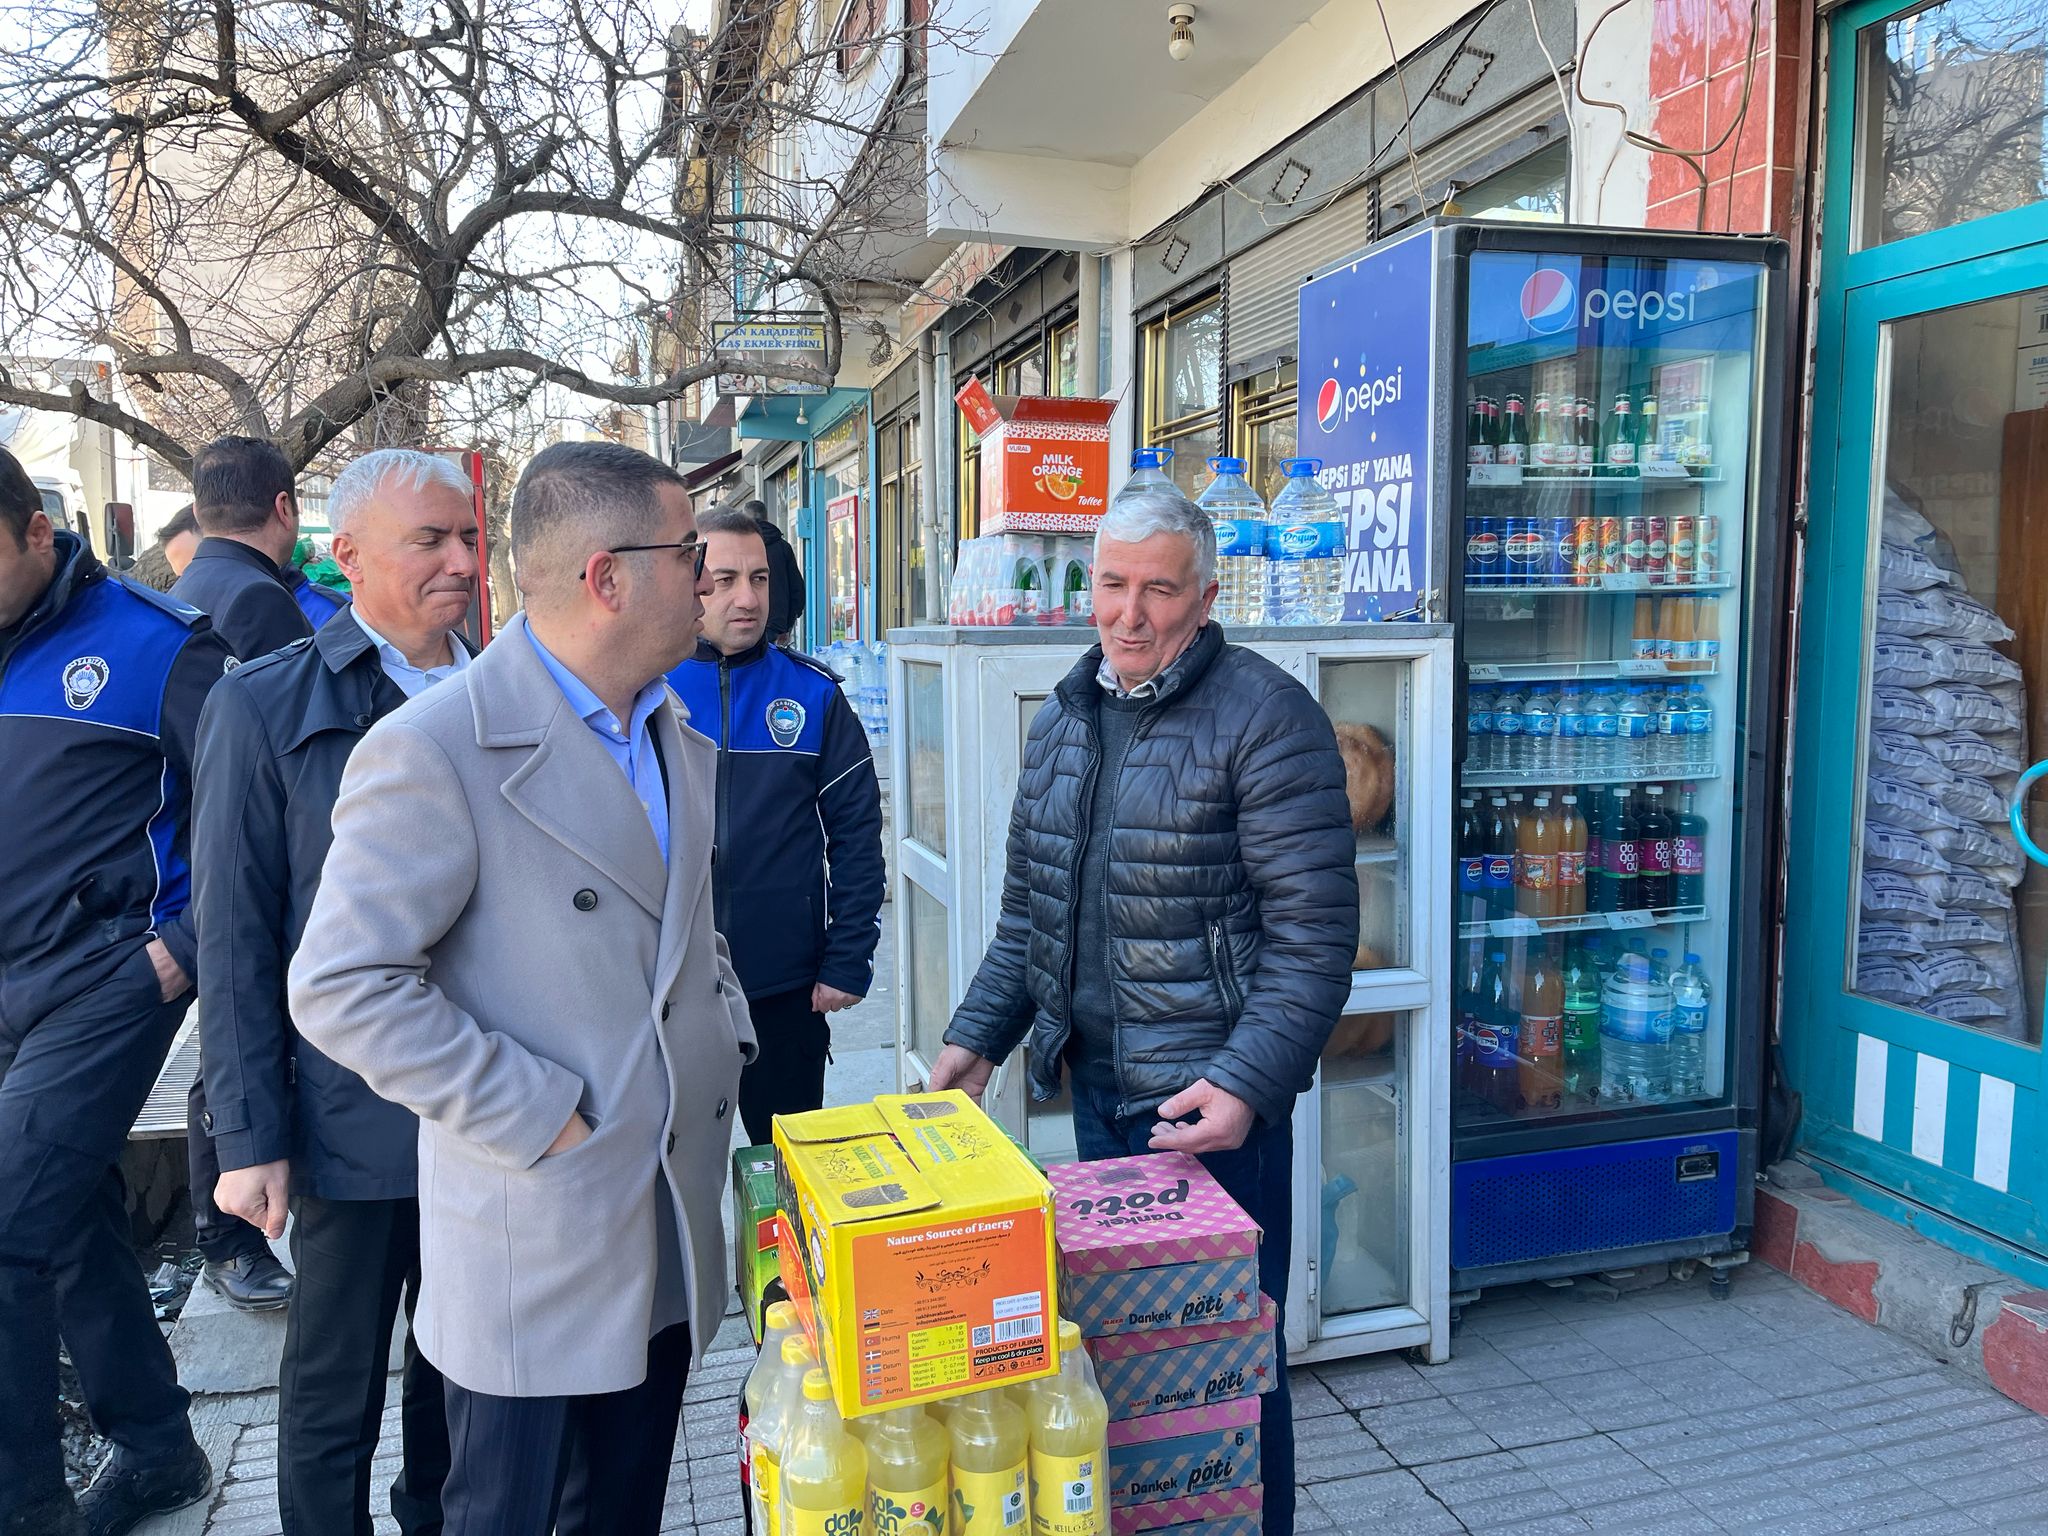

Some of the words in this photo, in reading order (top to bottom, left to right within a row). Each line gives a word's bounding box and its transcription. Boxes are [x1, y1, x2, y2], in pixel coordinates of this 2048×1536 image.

[1583, 284, 1697, 329] pepsi
[1345, 365, 1402, 422] pepsi
[1043, 454, 1073, 465] MILK
[1373, 453, 1412, 482] YANA
[1032, 464, 1083, 478] ORANGE
[1078, 495, 1103, 507] Toffee
[1283, 532, 1319, 546] Doyum
[1345, 548, 1412, 592] YANA
[1070, 1179, 1190, 1220] pöti
[1098, 1211, 1185, 1228] Dankek
[887, 1235, 924, 1247] Nature
[926, 1227, 963, 1240] Source
[966, 1225, 976, 1235] of
[978, 1218, 1015, 1233] Energy
[1128, 1309, 1172, 1325] Dankek
[1181, 1292, 1223, 1325] pöti
[976, 1344, 1008, 1355] PRODUCTS
[997, 1351, 1010, 1359] cool
[1026, 1347, 1042, 1355] place
[883, 1362, 901, 1370] Datum
[886, 1387, 904, 1395] Xurma
[1155, 1388, 1196, 1406] Dankek
[1204, 1368, 1244, 1402] pöti
[1235, 1432, 1244, 1447] 6
[1131, 1477, 1178, 1496] Dankek
[1187, 1456, 1233, 1493] pöti
[824, 1513, 850, 1534] do
